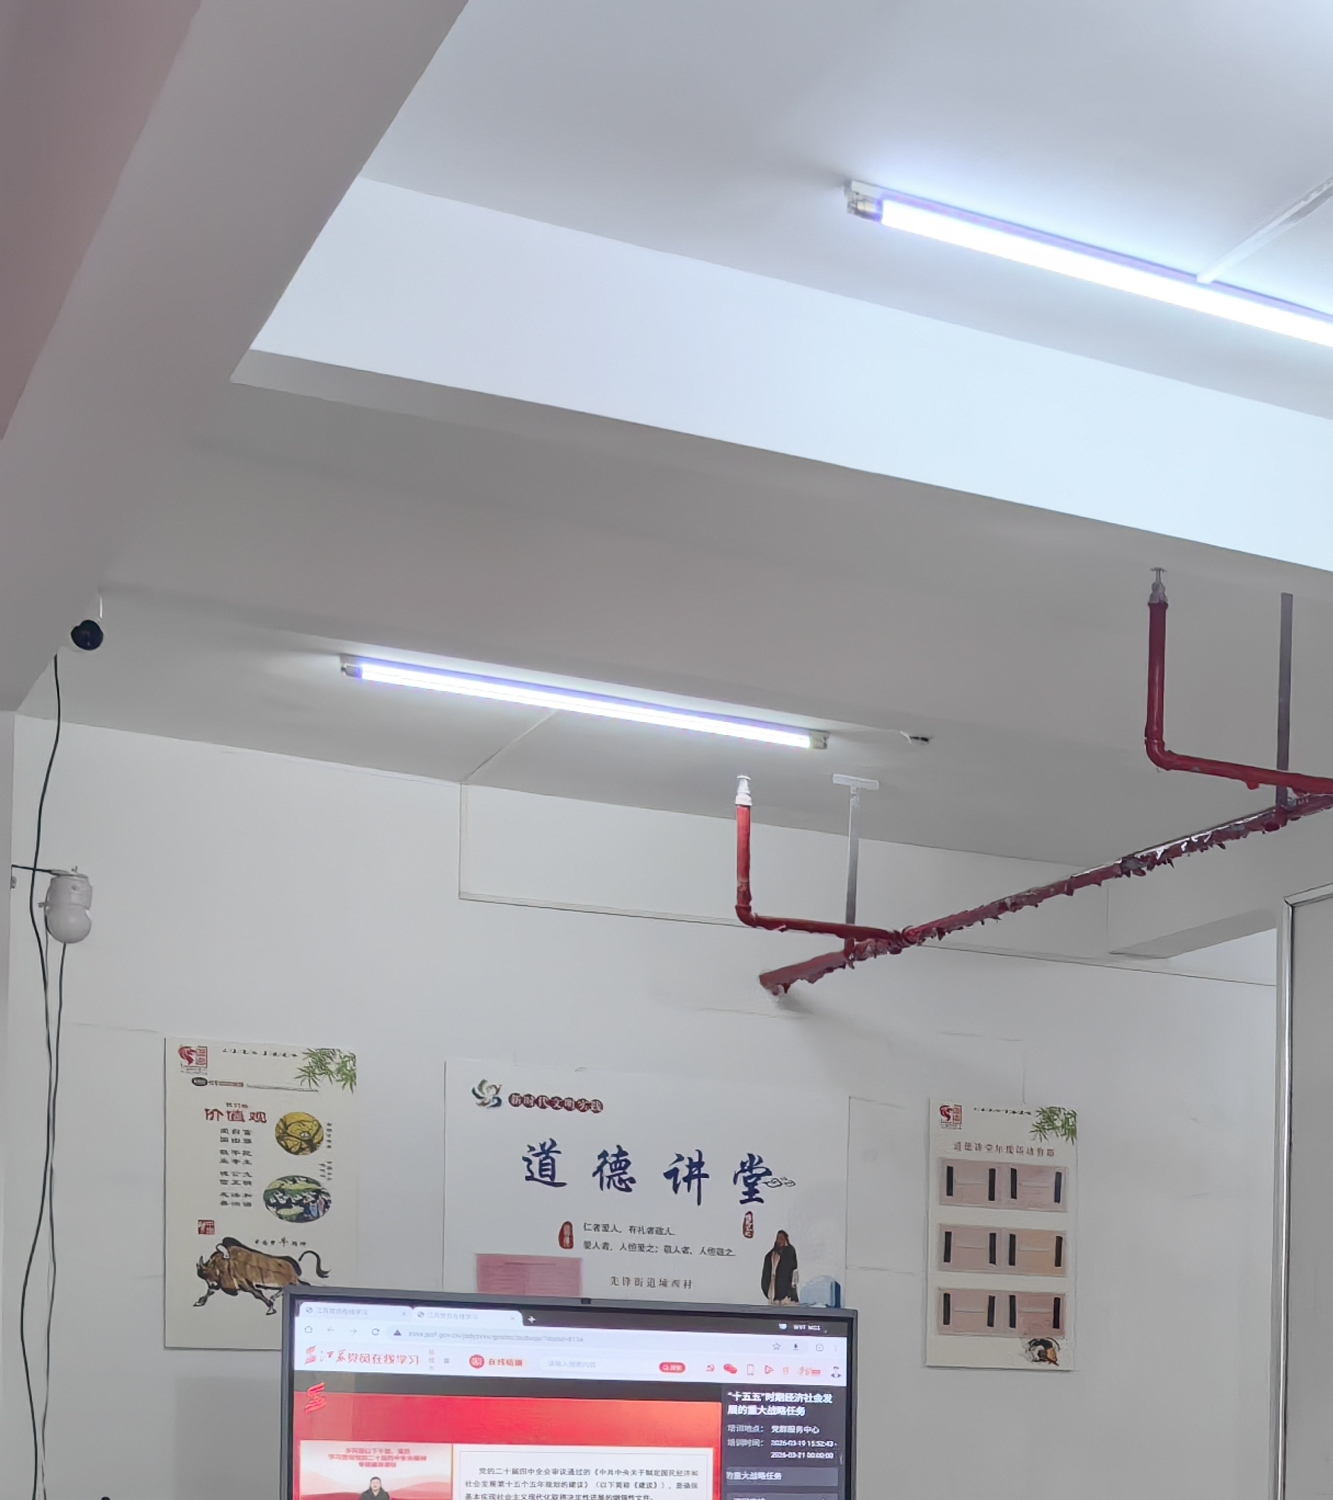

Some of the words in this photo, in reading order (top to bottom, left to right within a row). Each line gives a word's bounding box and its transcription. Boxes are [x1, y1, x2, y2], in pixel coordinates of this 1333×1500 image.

[204, 1108, 268, 1123] 价值观
[521, 1137, 775, 1206] 道德讲堂
